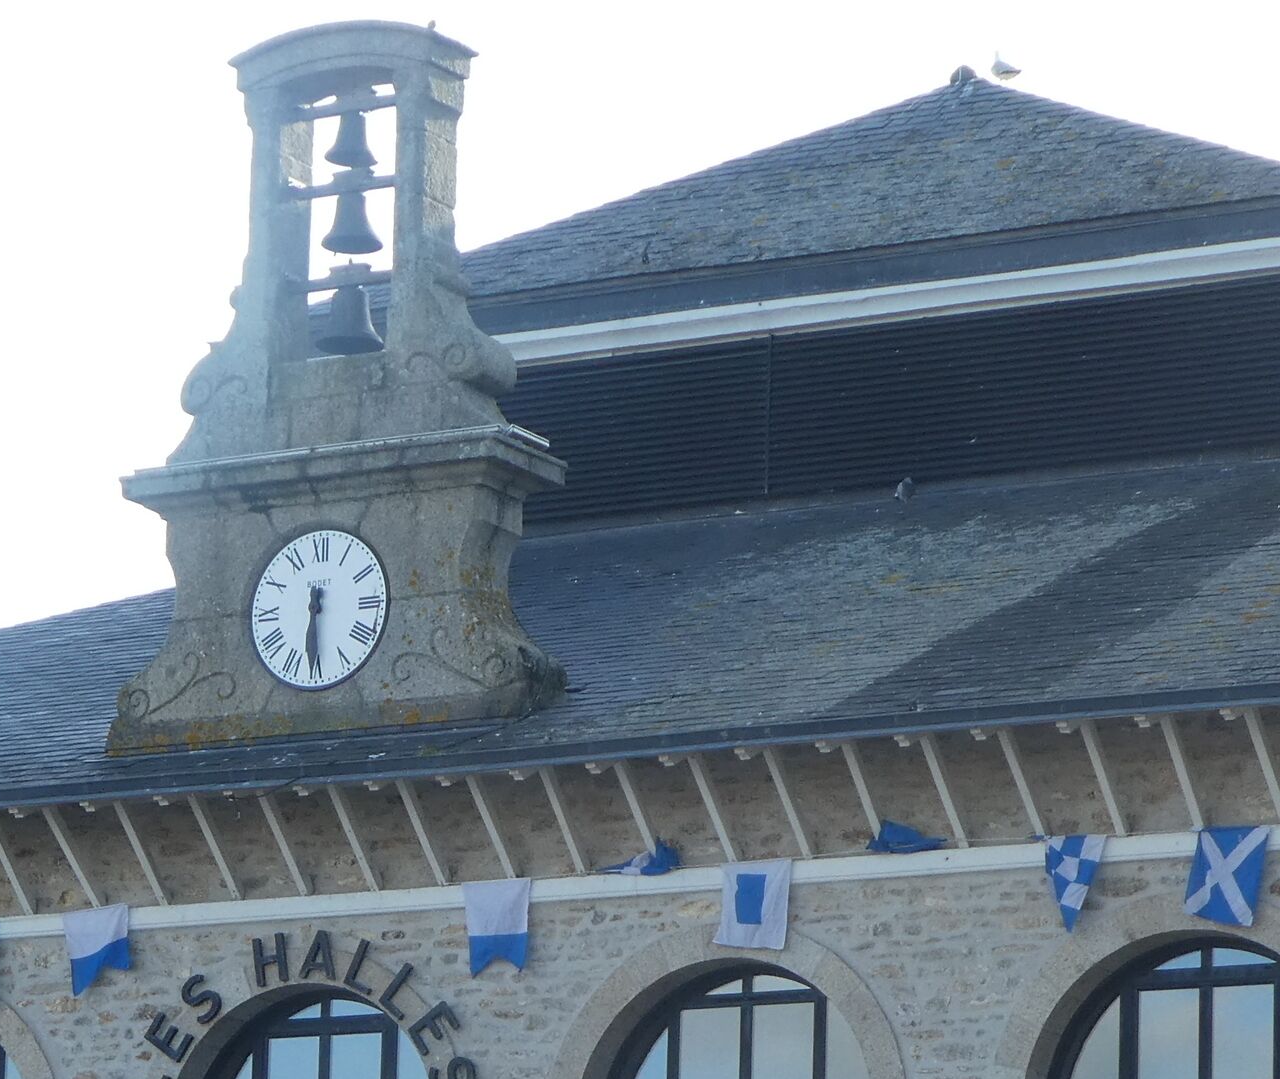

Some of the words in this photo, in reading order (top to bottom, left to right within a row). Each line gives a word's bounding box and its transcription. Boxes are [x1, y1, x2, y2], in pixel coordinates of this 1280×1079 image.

[285, 547, 305, 575] XI
[312, 537, 329, 563] XII
[266, 575, 287, 593] X
[307, 578, 332, 588] BODET
[352, 563, 374, 584] II
[358, 595, 380, 610] III
[258, 606, 280, 623] IX
[261, 627, 287, 660] VIII
[282, 647, 303, 677] VII
[336, 646, 351, 670] V
